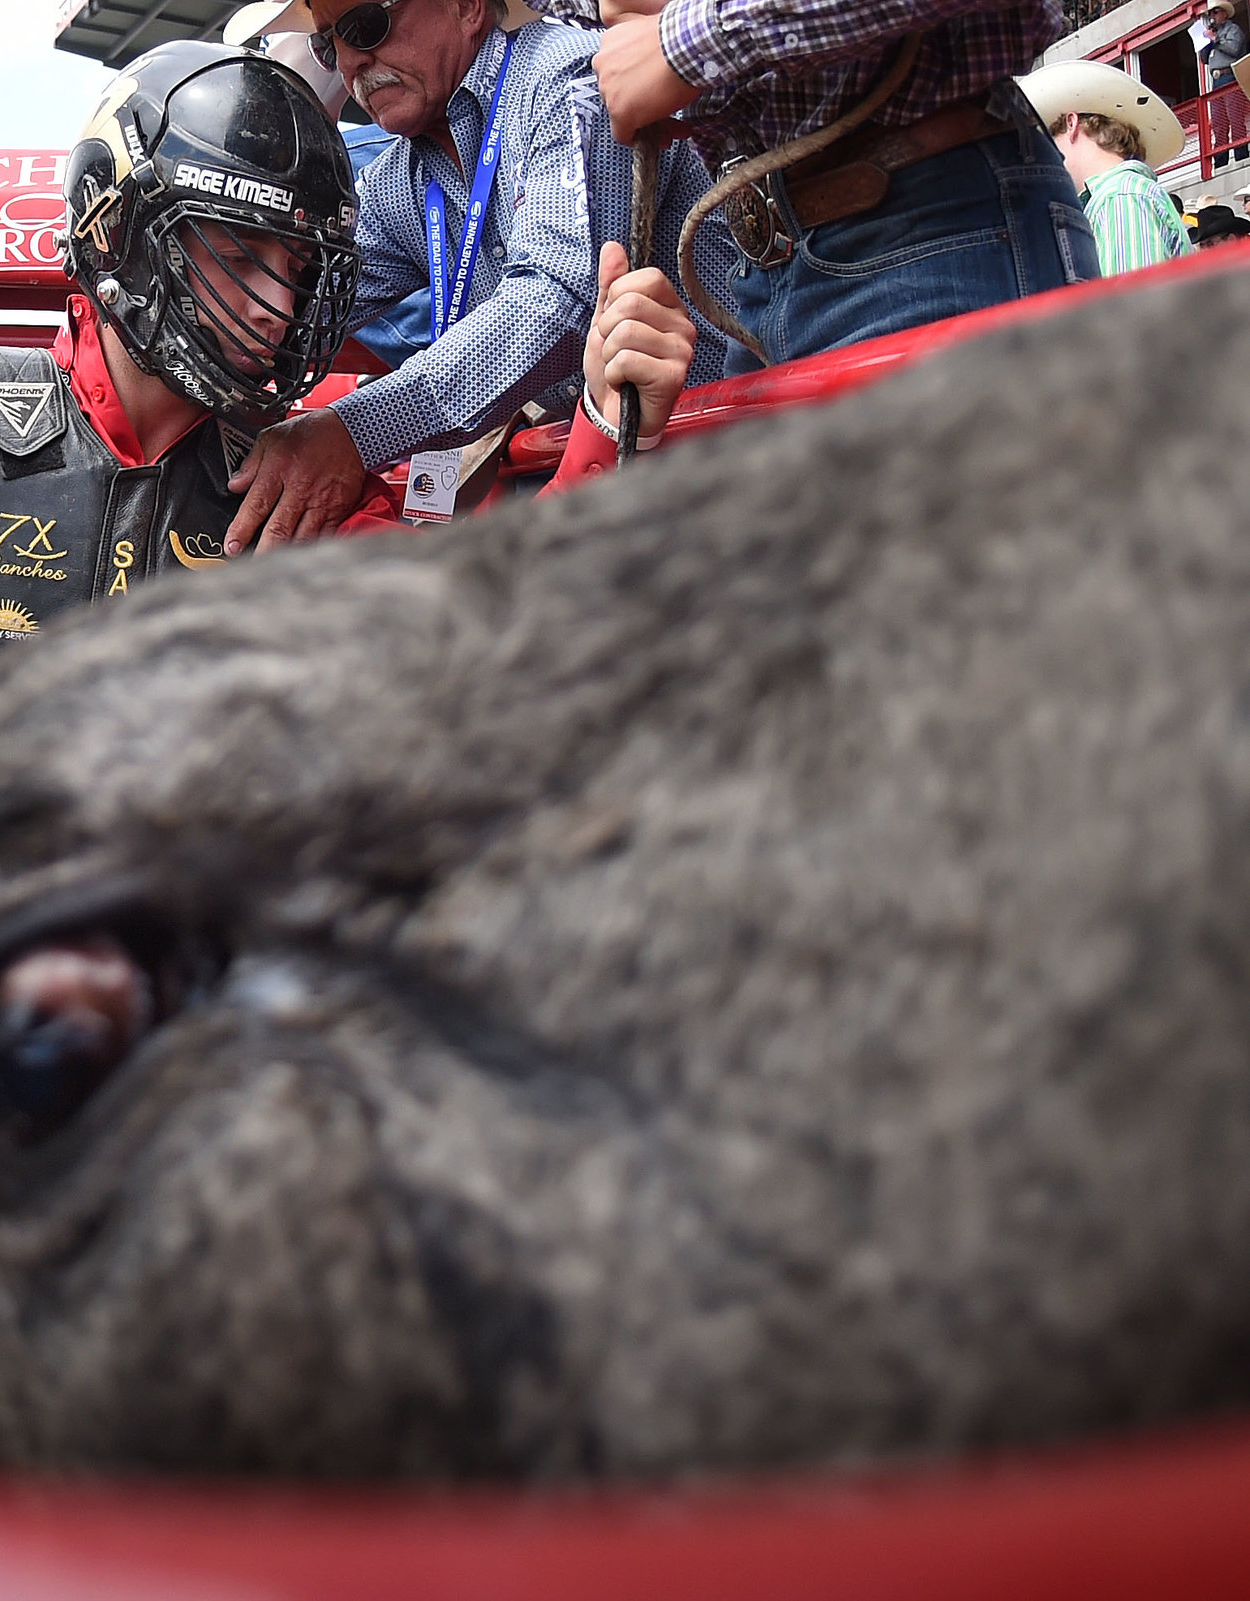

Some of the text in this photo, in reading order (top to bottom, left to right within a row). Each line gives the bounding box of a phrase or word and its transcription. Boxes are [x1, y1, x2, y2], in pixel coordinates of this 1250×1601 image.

[487, 130, 500, 147] THE
[174, 164, 293, 213] SAGE KIMZEY
[431, 224, 444, 324] THE ROAD TO CHEYENNE
[447, 220, 478, 324] THE ROAD TO CHEYENNE
[108, 540, 135, 597] SA
